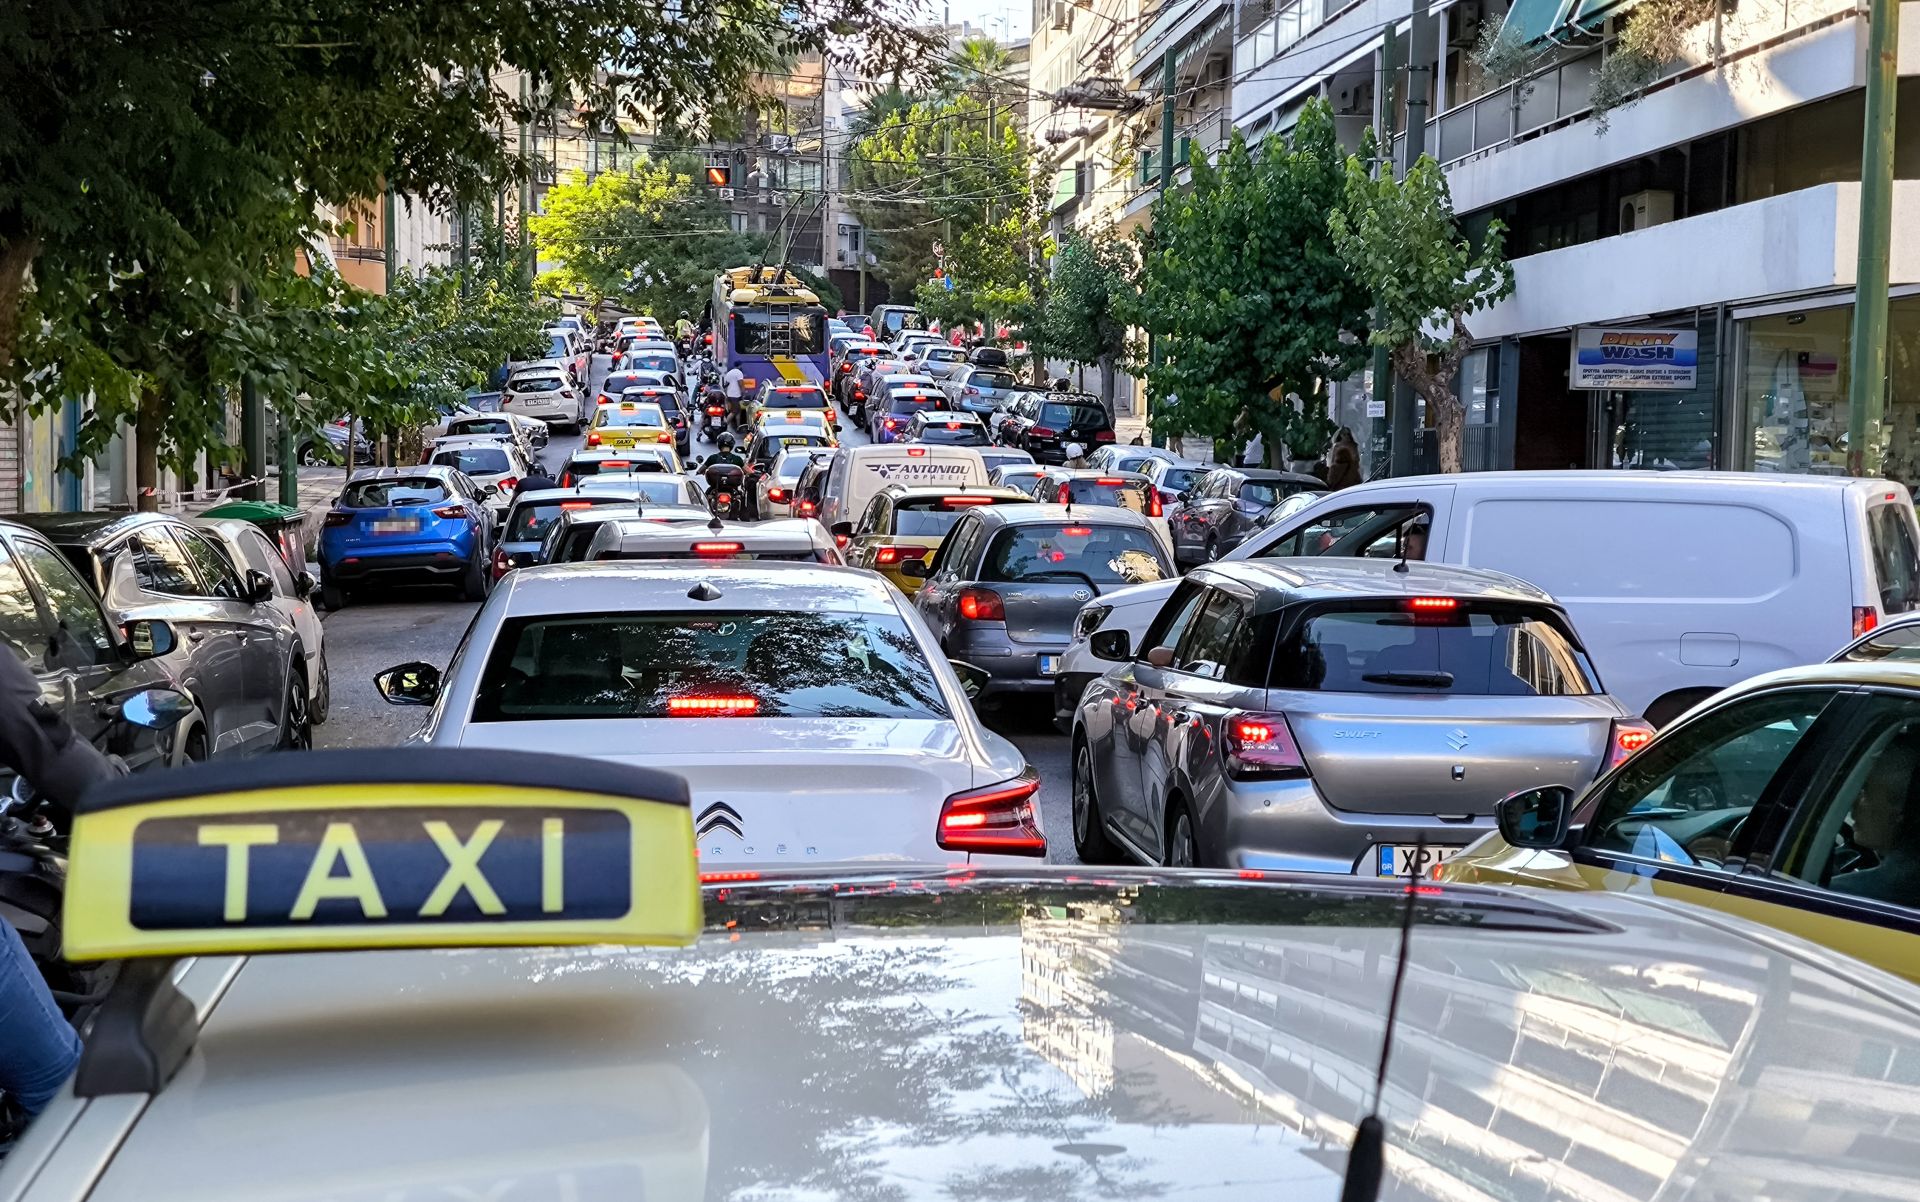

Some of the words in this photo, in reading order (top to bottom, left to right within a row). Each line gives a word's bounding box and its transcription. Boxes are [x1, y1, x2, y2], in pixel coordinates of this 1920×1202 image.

[1600, 332, 1679, 346] DIRTY
[1602, 346, 1675, 360] WASH
[900, 465, 970, 474] ANTONIOU
[1334, 730, 1383, 738] SWIFT
[197, 818, 564, 921] TAXI
[1382, 863, 1393, 871] GR
